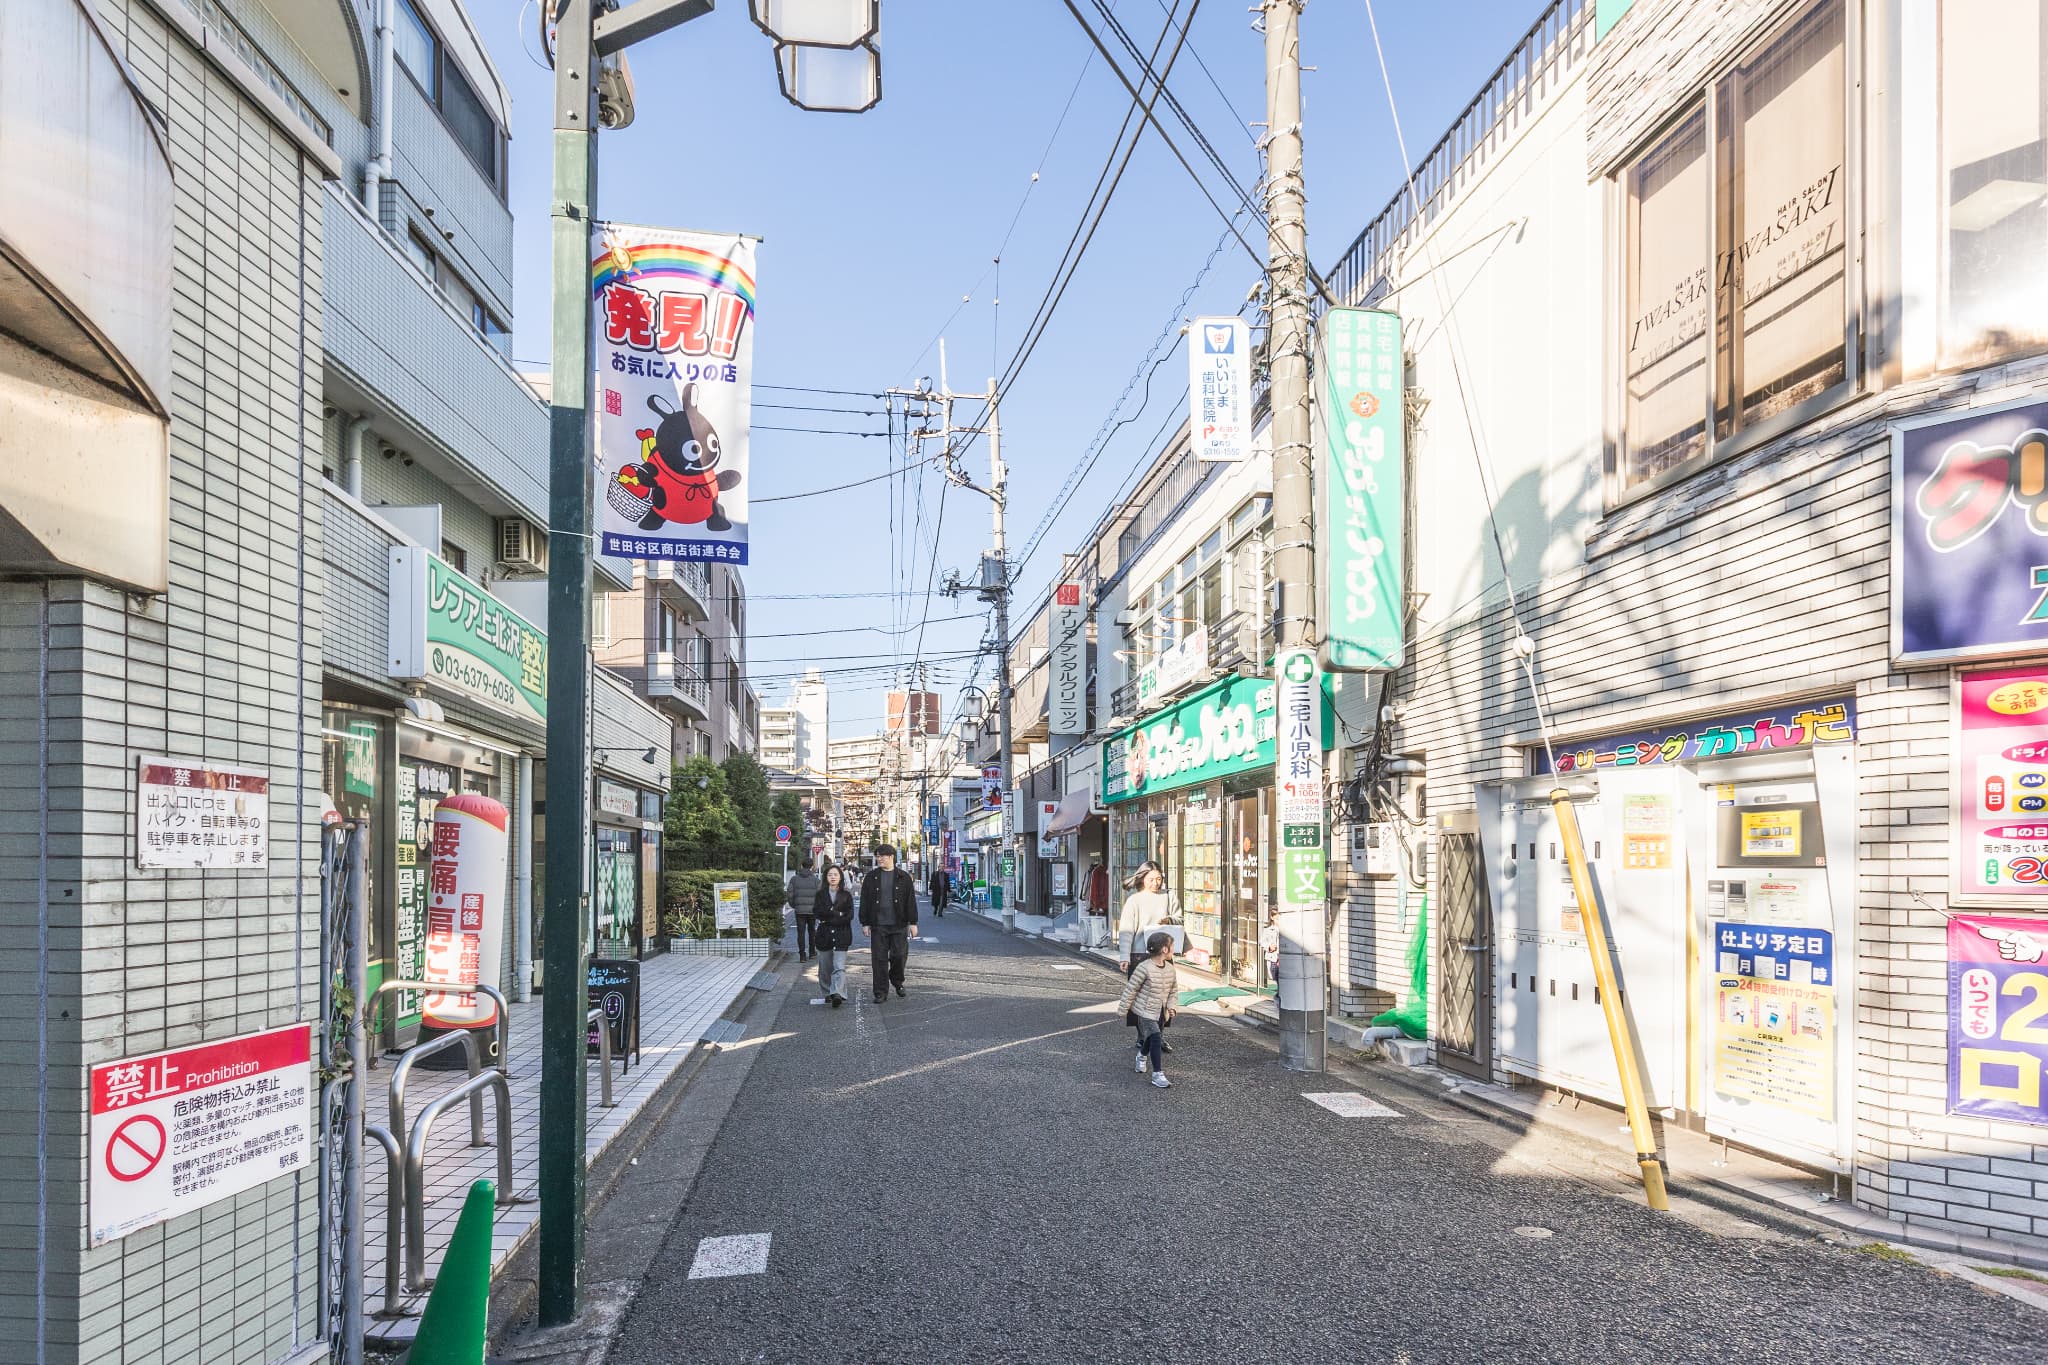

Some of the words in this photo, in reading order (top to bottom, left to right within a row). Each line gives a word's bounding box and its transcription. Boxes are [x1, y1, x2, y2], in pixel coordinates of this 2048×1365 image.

[1777, 197, 1798, 216] HAIR
[1802, 175, 1828, 199] SALON
[1674, 275, 1692, 292] HAIR
[611, 352, 737, 383] お気に入りの店
[1215, 356, 1229, 408] いいじま
[1202, 371, 1217, 423] 歯科医院
[609, 537, 741, 559] 世田谷区商店街連合会
[445, 655, 515, 704] 03-6379-6058
[1059, 609, 1079, 730] ナリタデンタルクリニック
[2010, 698, 2038, 711] お得
[1289, 685, 1312, 779] 三宅小児科
[1556, 733, 1689, 773] クリーニング
[1694, 704, 1851, 757] かんだ
[174, 769, 242, 792] 禁止
[2021, 776, 2044, 786] AM
[147, 793, 226, 811] 出入口につき
[1987, 783, 2003, 805] 毎日
[2021, 799, 2043, 808] PM
[147, 831, 261, 847] 駐停車を禁止します
[1289, 827, 1315, 836] 上北沢
[1291, 837, 1313, 845] 4-14
[1294, 864, 1321, 893] 文
[461, 895, 481, 926] 産後
[1721, 930, 1823, 955] 仕上り予定日
[1739, 959, 1751, 973] 月
[1775, 963, 1787, 977] 日
[1812, 967, 1827, 982] 時
[1739, 978, 1828, 1001] 24時間受付けロッカー
[1968, 974, 1989, 1035] いつでも
[105, 1057, 181, 1109] 禁止
[185, 1059, 260, 1089] Prohibition
[173, 1075, 281, 1118] 危険物持込み禁止
[278, 1152, 300, 1169] 駅長
